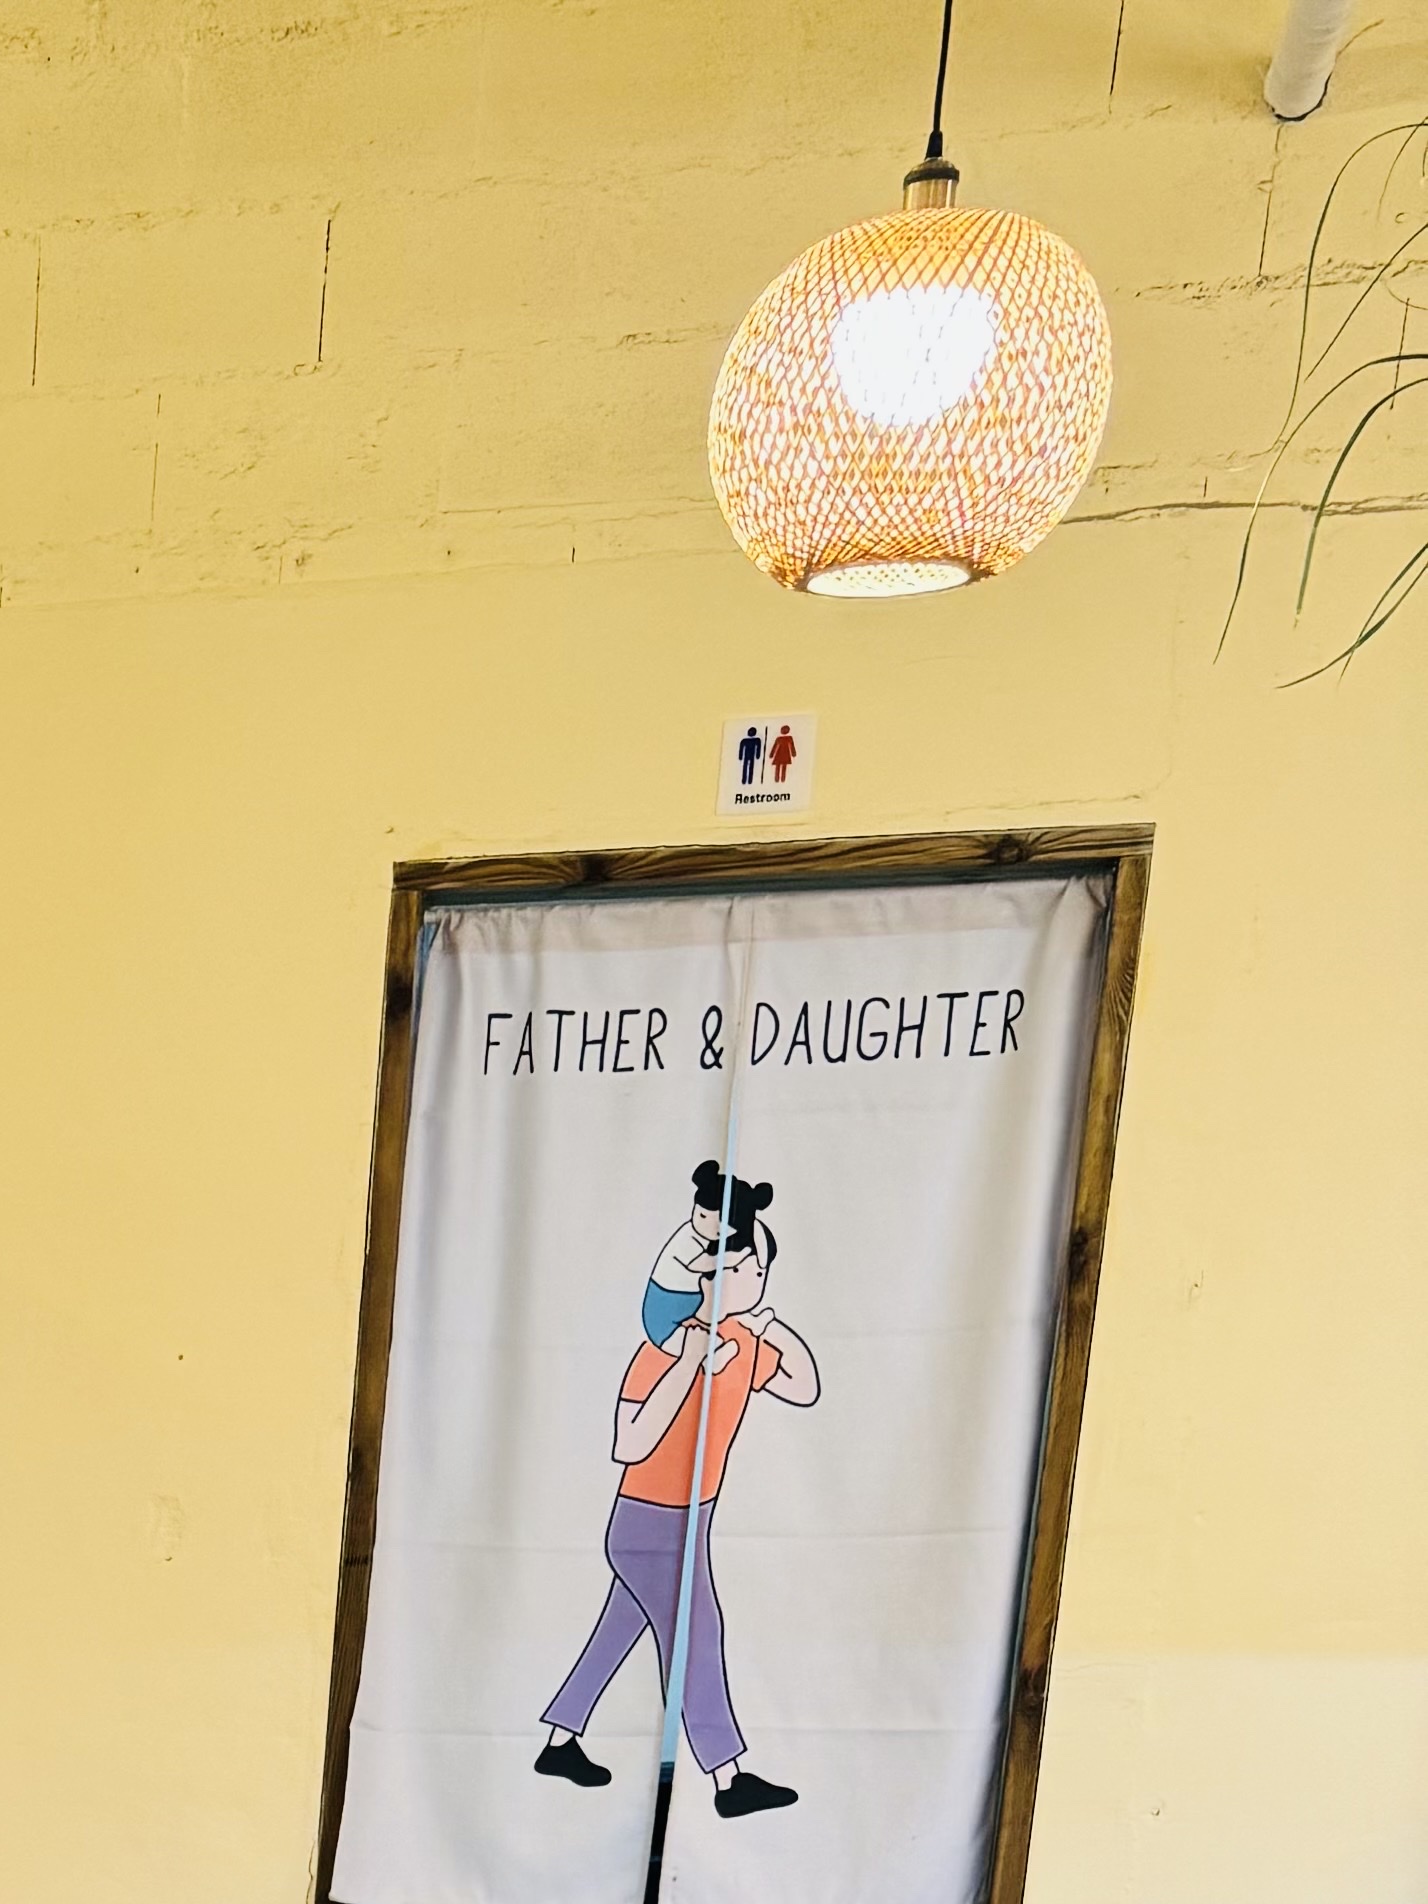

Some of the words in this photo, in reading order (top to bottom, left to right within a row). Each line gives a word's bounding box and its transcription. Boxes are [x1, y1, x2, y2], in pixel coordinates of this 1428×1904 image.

[734, 793, 791, 805] Restroom
[482, 1008, 669, 1076] FATHER
[698, 1004, 726, 1071] &
[749, 988, 1026, 1067] DAUGHTER
